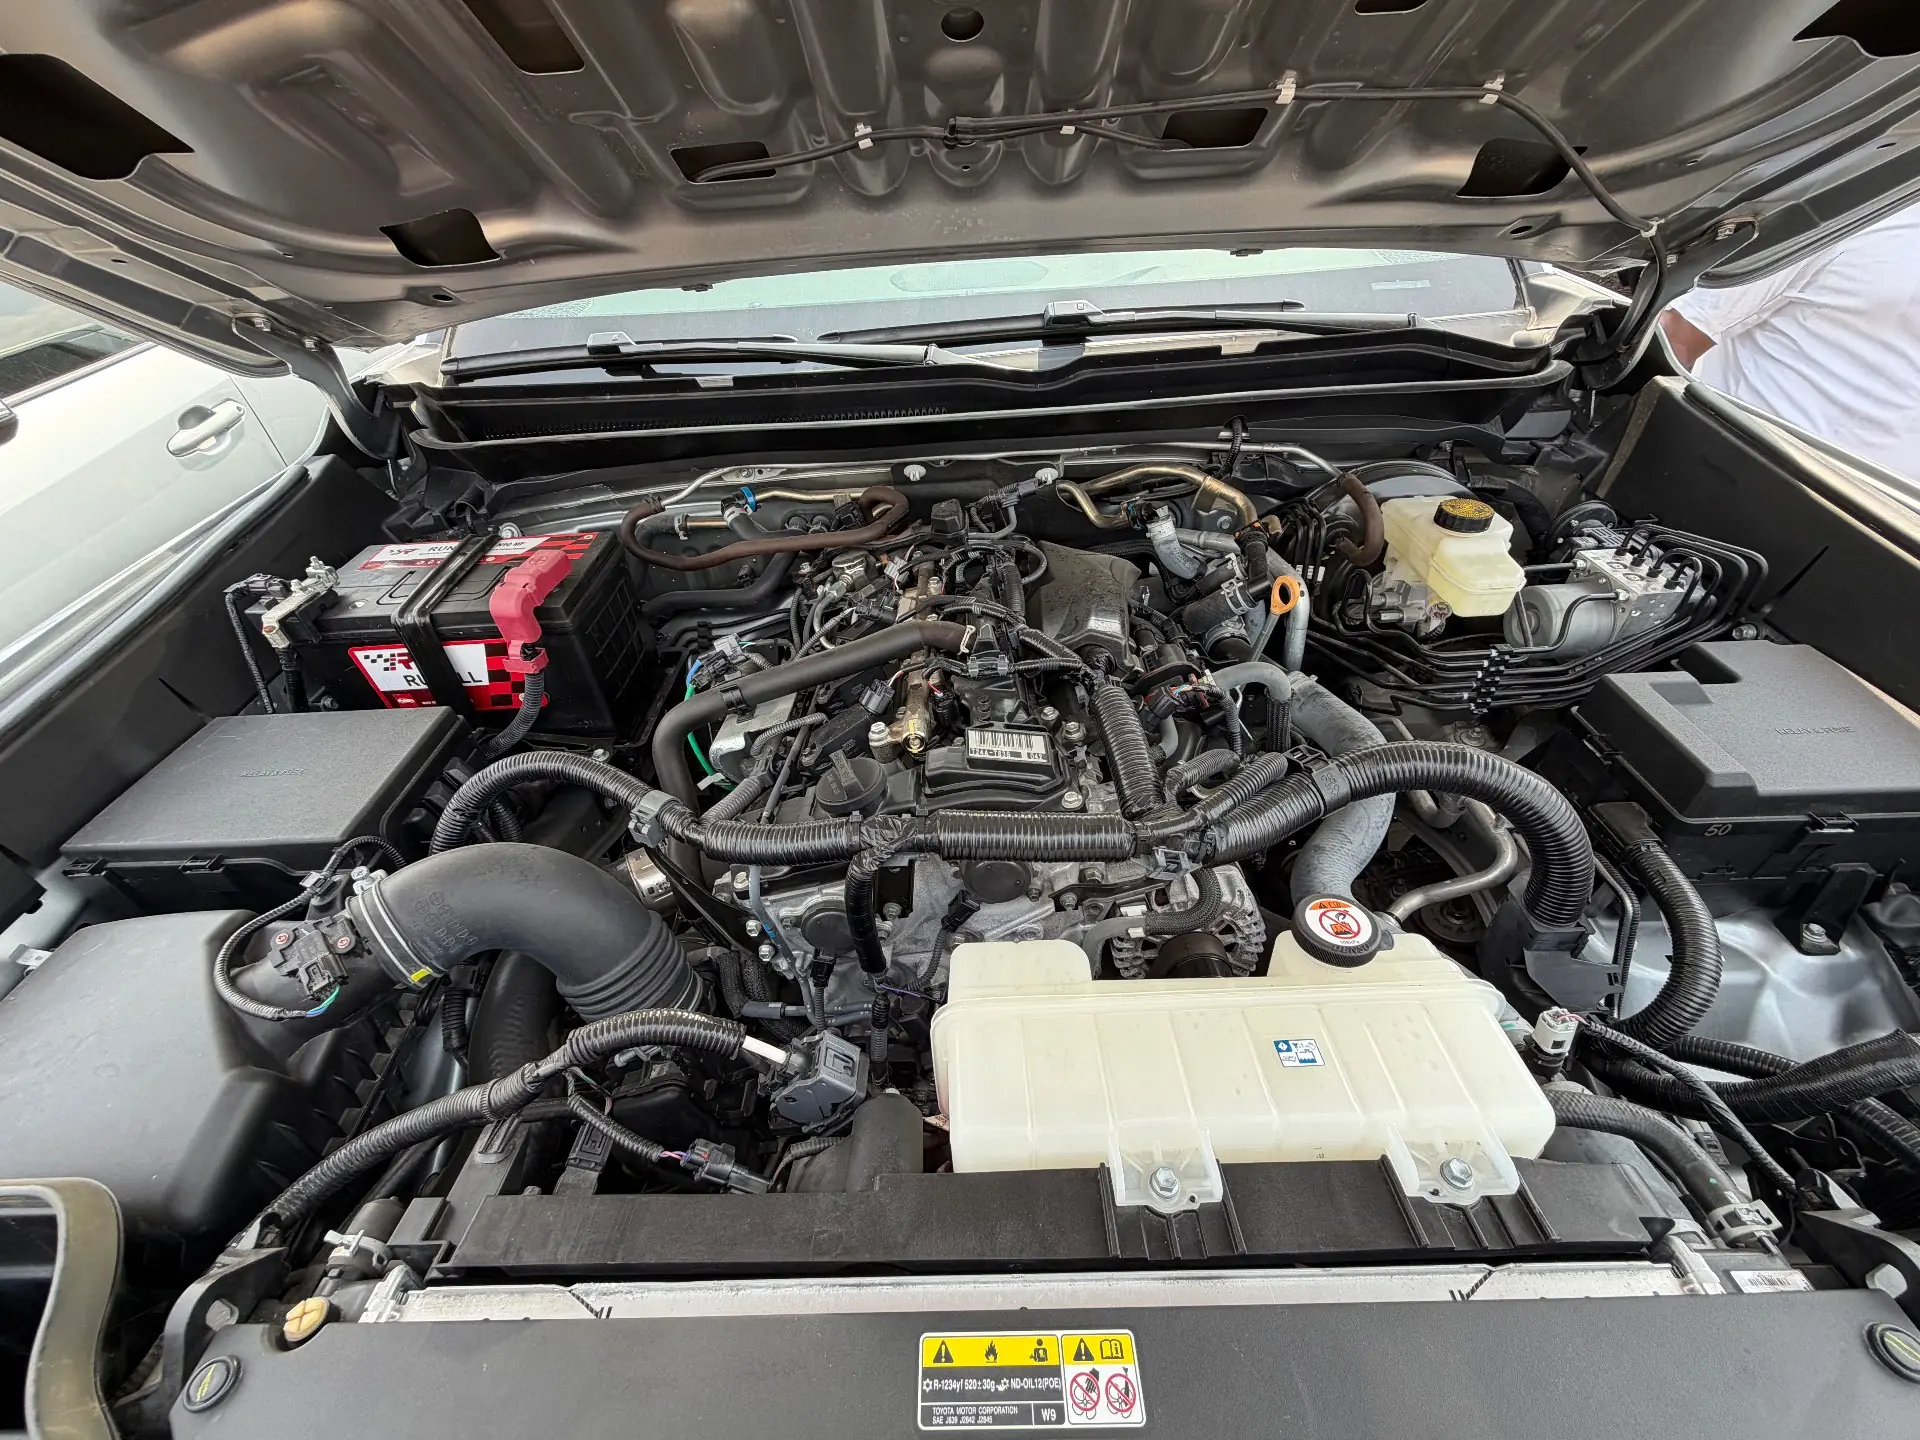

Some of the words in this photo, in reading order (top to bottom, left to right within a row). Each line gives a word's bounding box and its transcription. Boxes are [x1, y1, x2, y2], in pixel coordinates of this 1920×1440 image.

[1704, 823, 1733, 837] 50
[1332, 943, 1371, 954] DENSO
[933, 1378, 963, 1392] R-1234yf
[964, 1377, 996, 1392] 520±30g
[1010, 1377, 1061, 1390] ND-OIL12(POE)
[932, 1406, 955, 1416] TOYOTA
[956, 1406, 977, 1416] MOTOR
[978, 1405, 1019, 1415] CORPORATION
[1041, 1407, 1057, 1422] W9
[932, 1415, 944, 1425] SAE
